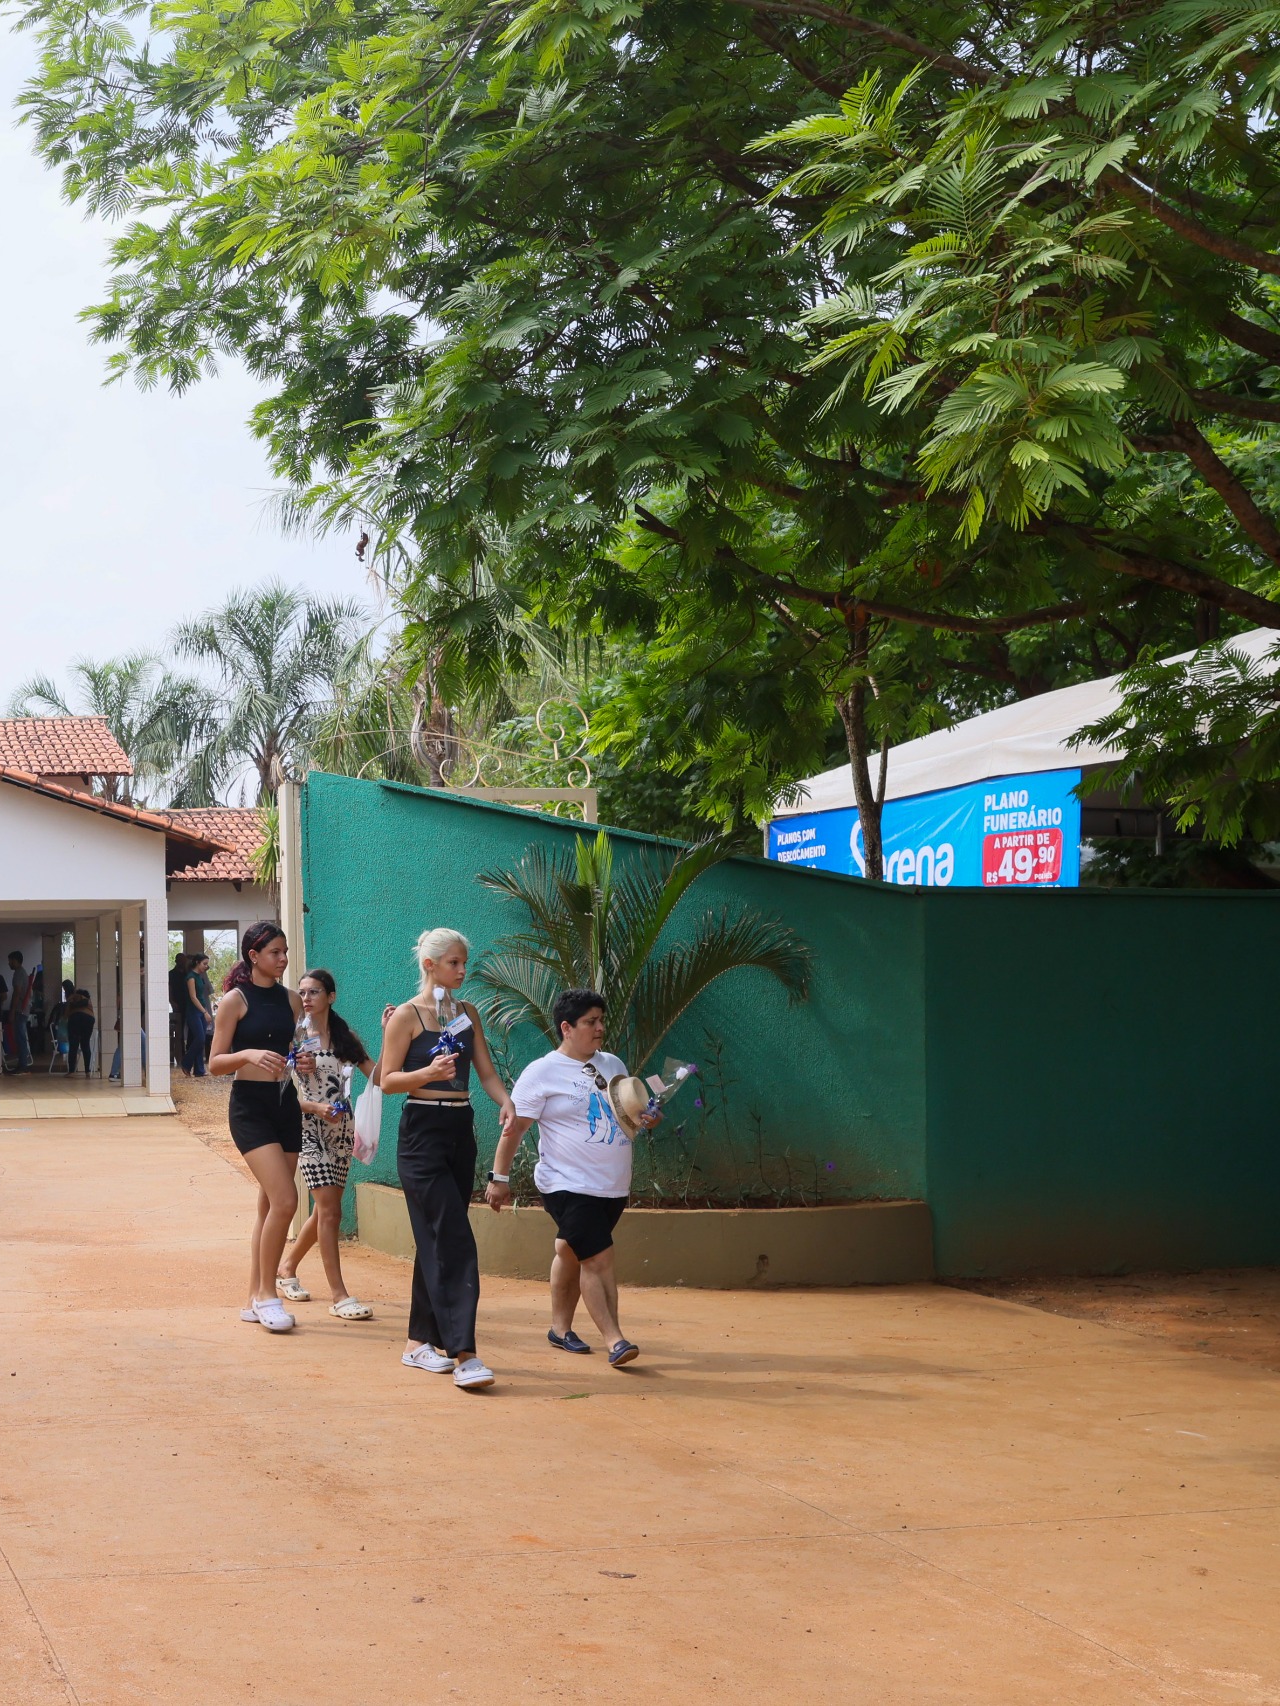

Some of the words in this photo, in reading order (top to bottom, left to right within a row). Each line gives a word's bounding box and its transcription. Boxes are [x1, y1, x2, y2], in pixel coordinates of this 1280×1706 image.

[984, 789, 1029, 812] PLANO
[983, 804, 1062, 833] FUNERÁRIO
[777, 830, 801, 846] PLANOS
[801, 827, 816, 841] COM
[993, 837, 1001, 849] A
[1001, 833, 1035, 848] PARTIR
[1036, 832, 1050, 845] DE
